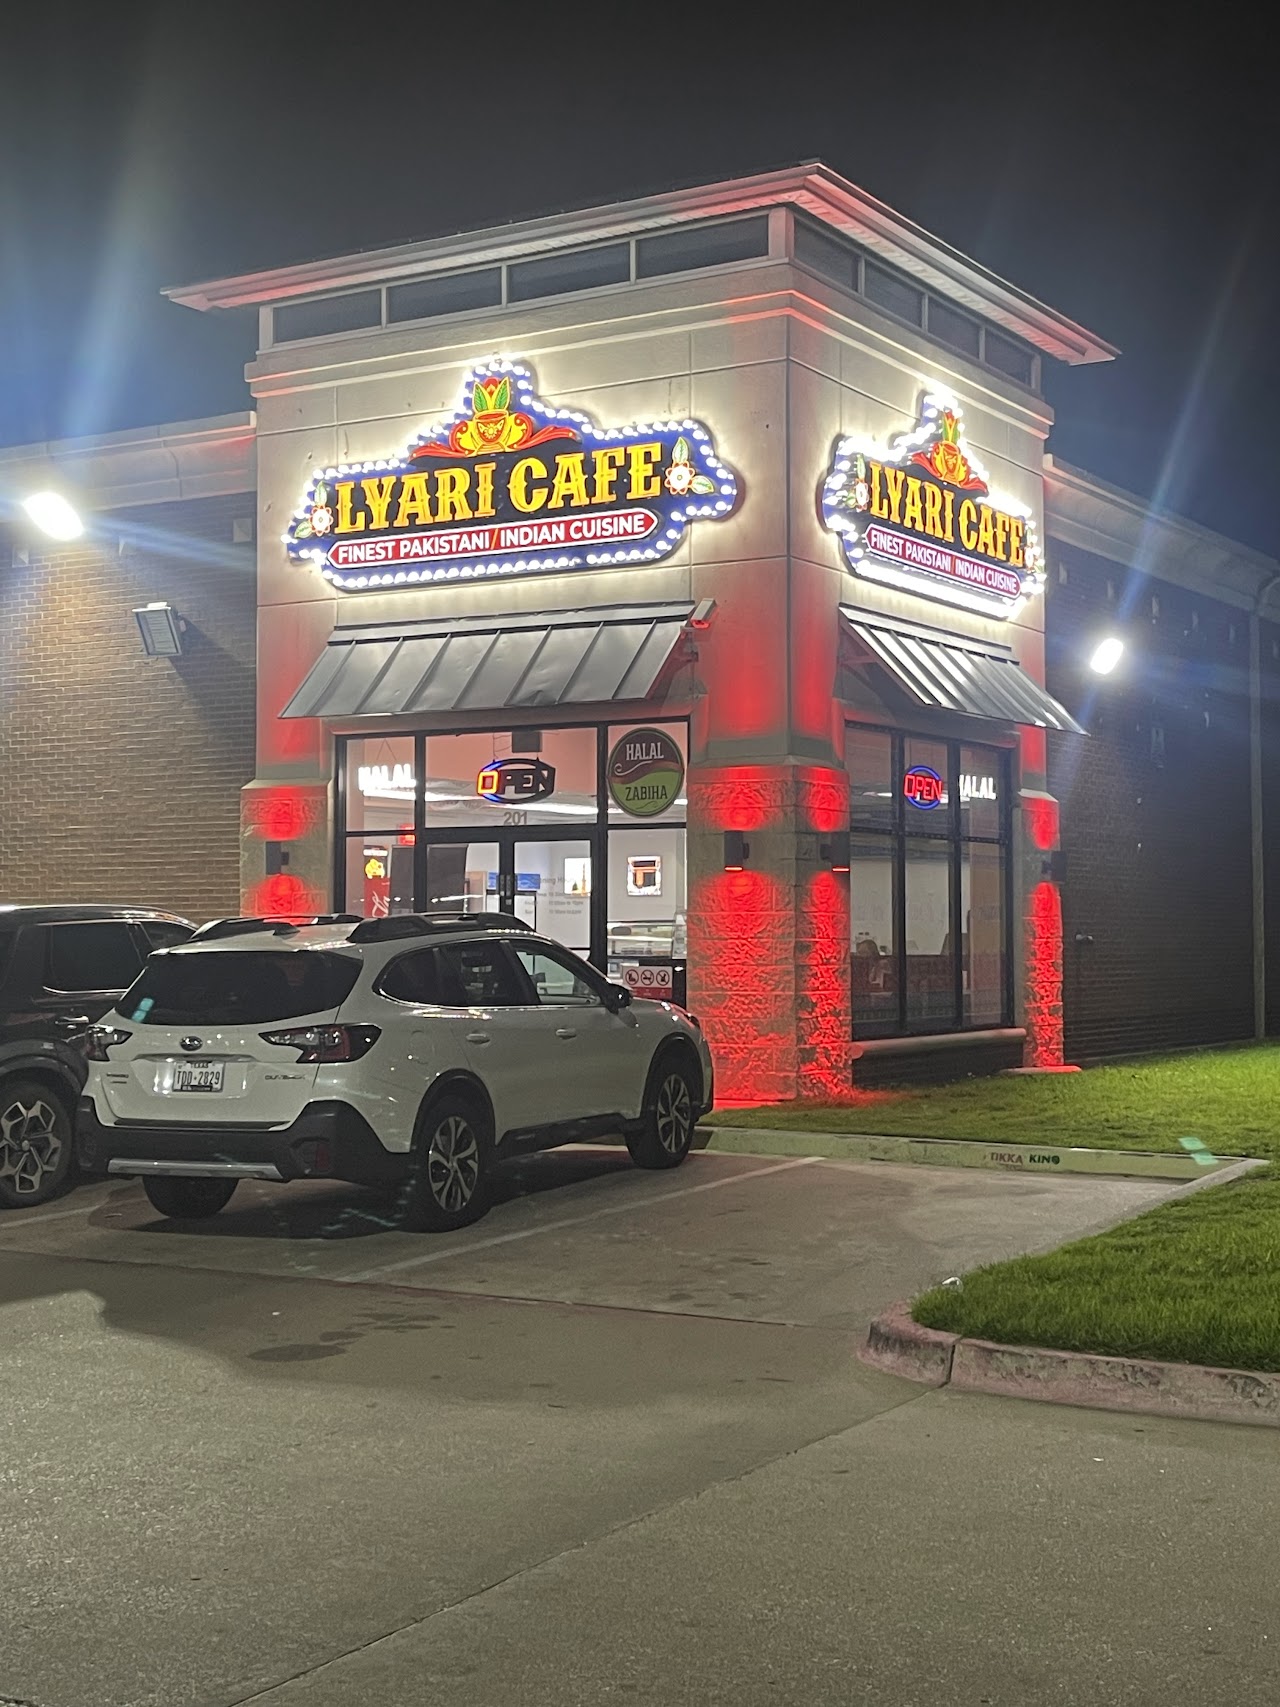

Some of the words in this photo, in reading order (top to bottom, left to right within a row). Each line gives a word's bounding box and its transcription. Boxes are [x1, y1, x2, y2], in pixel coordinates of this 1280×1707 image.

[334, 462, 497, 535] LYARI
[507, 442, 663, 514] CAFE
[868, 460, 955, 543] LYARI
[958, 499, 1025, 569] CAFE
[338, 541, 396, 564] FINEST
[569, 514, 646, 540] CUISINE
[870, 529, 904, 557] FINEST
[986, 568, 1018, 594] CUISINE
[625, 742, 665, 761] HALAL
[358, 763, 417, 792] HALAL
[477, 768, 556, 797] OPEN
[903, 774, 943, 801] OPEN
[625, 785, 668, 801] ZABIHA
[503, 811, 528, 827] 201
